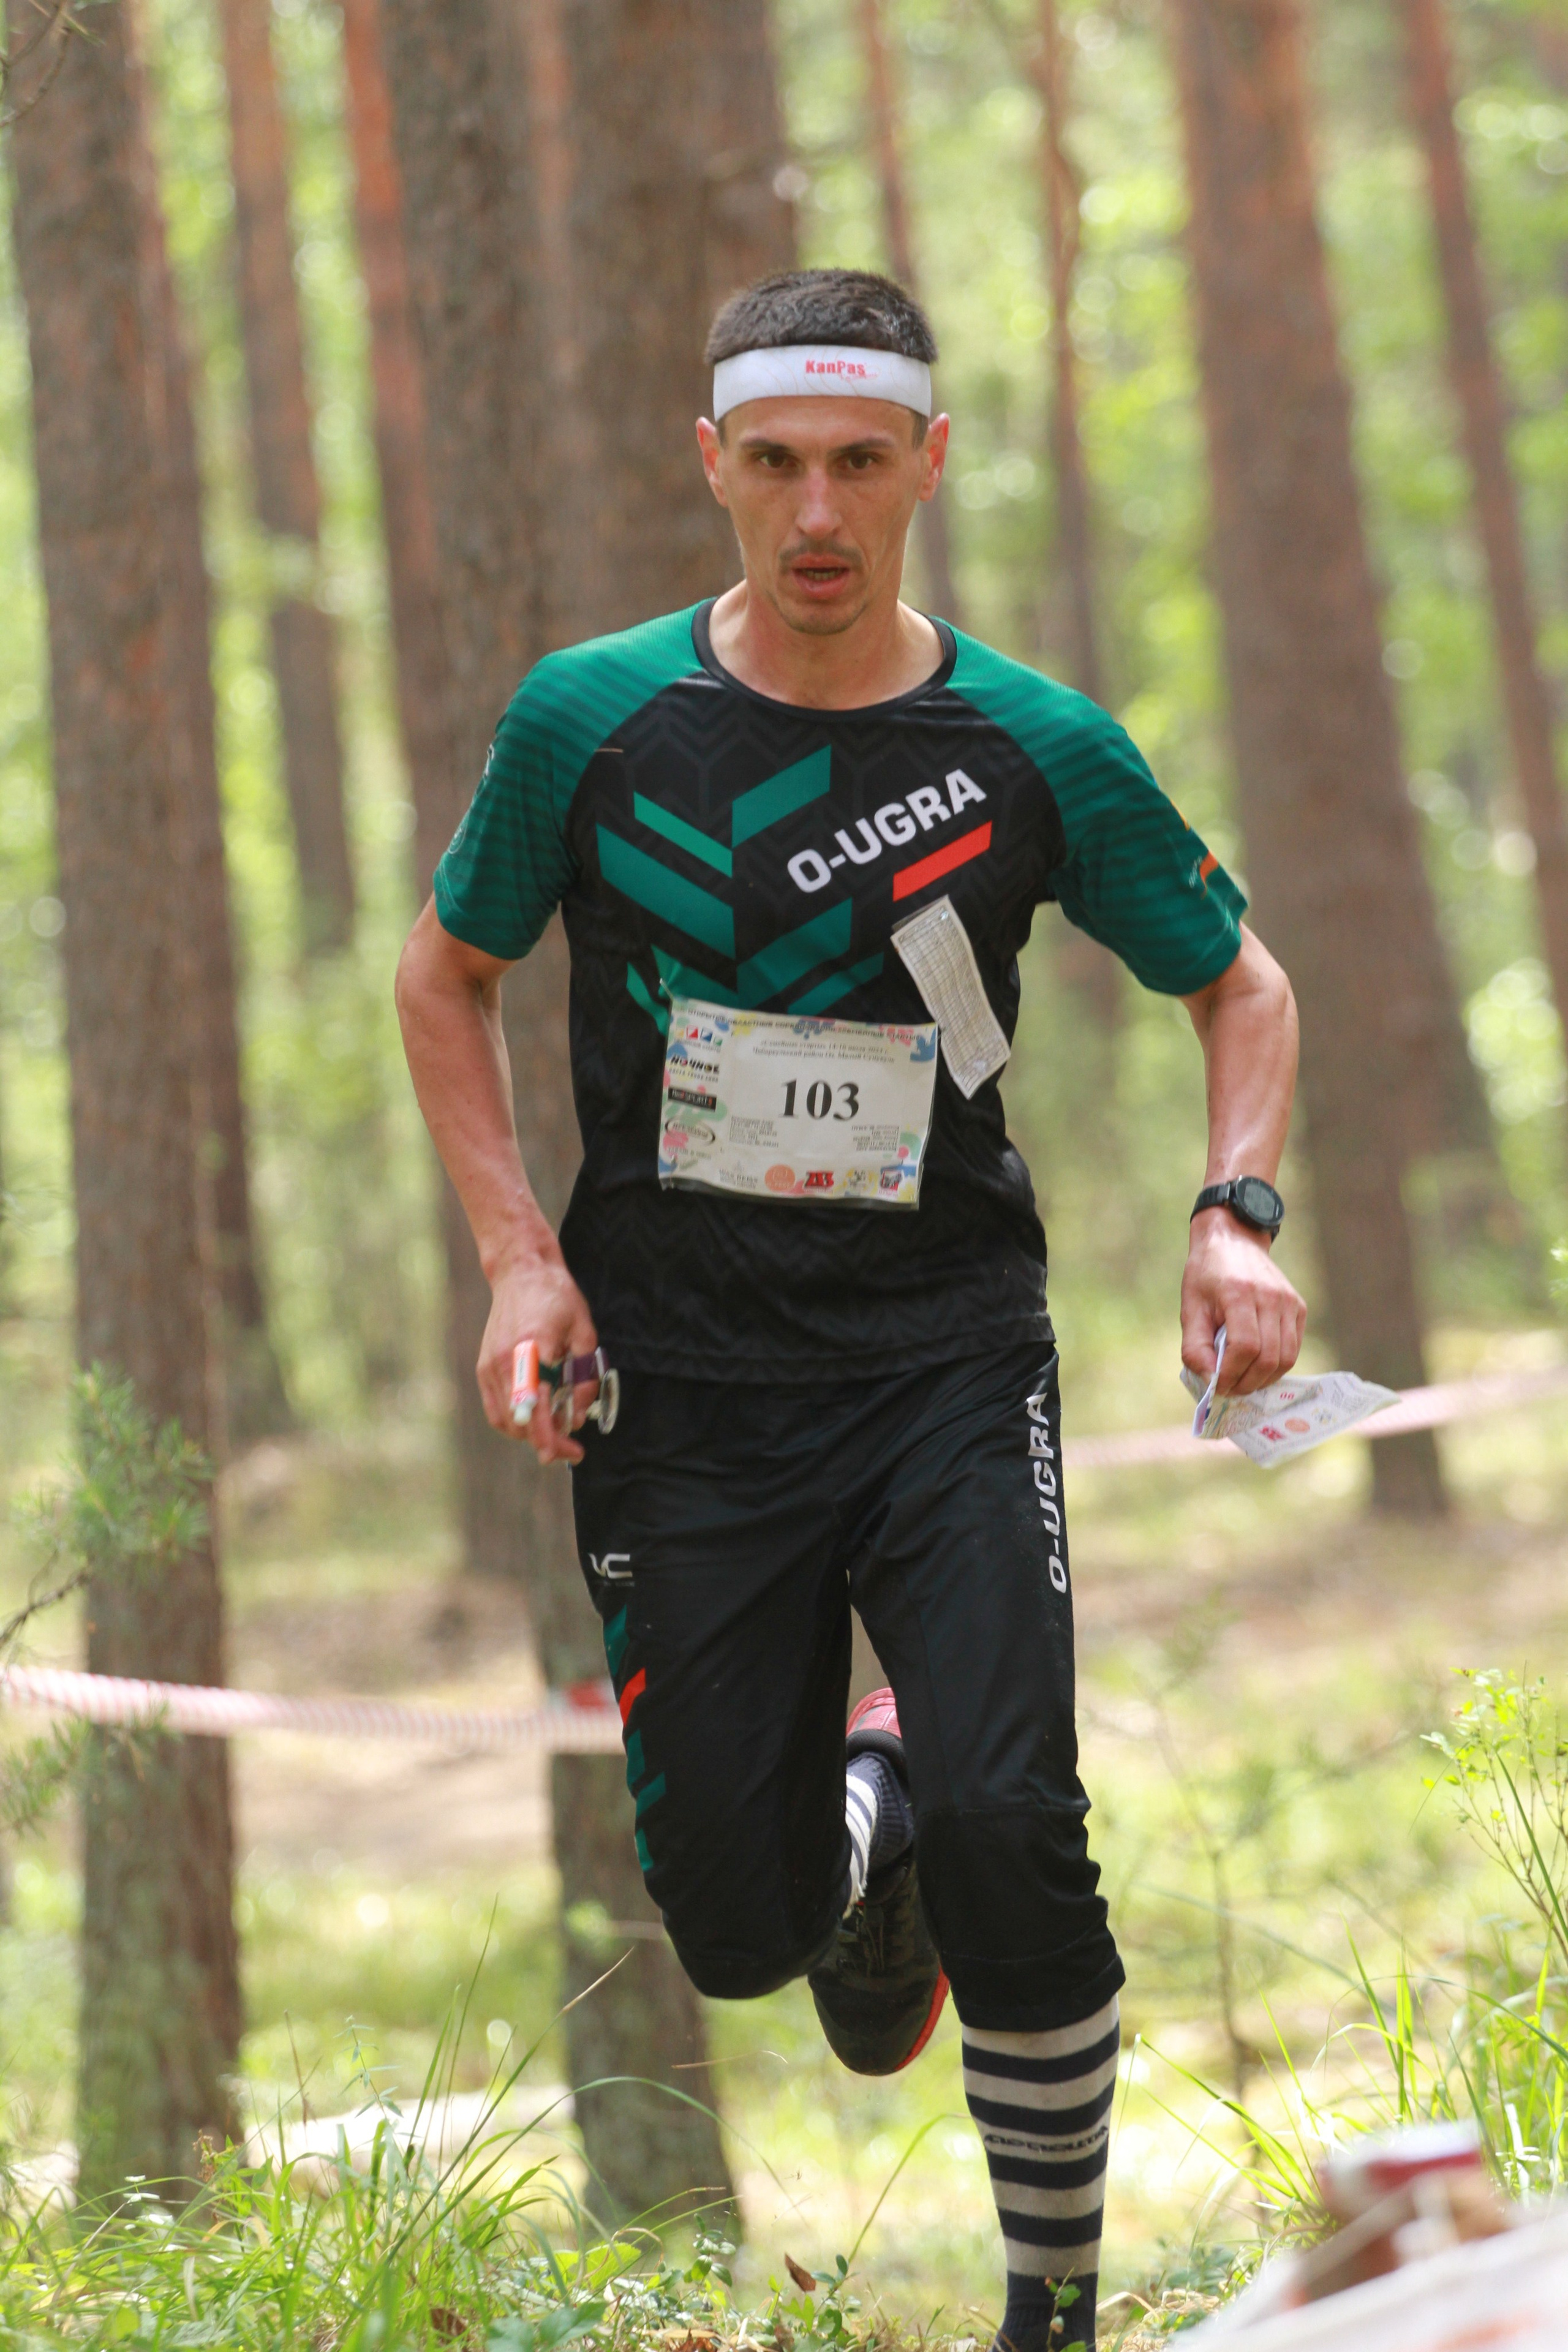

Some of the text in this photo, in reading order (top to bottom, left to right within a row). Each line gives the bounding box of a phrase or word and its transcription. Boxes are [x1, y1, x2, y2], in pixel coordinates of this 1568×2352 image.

[805, 360, 866, 377] KanPas
[787, 768, 987, 893] O-UGRA
[778, 1079, 859, 1121] 103
[1027, 1392, 1067, 1594] O-UGRA
